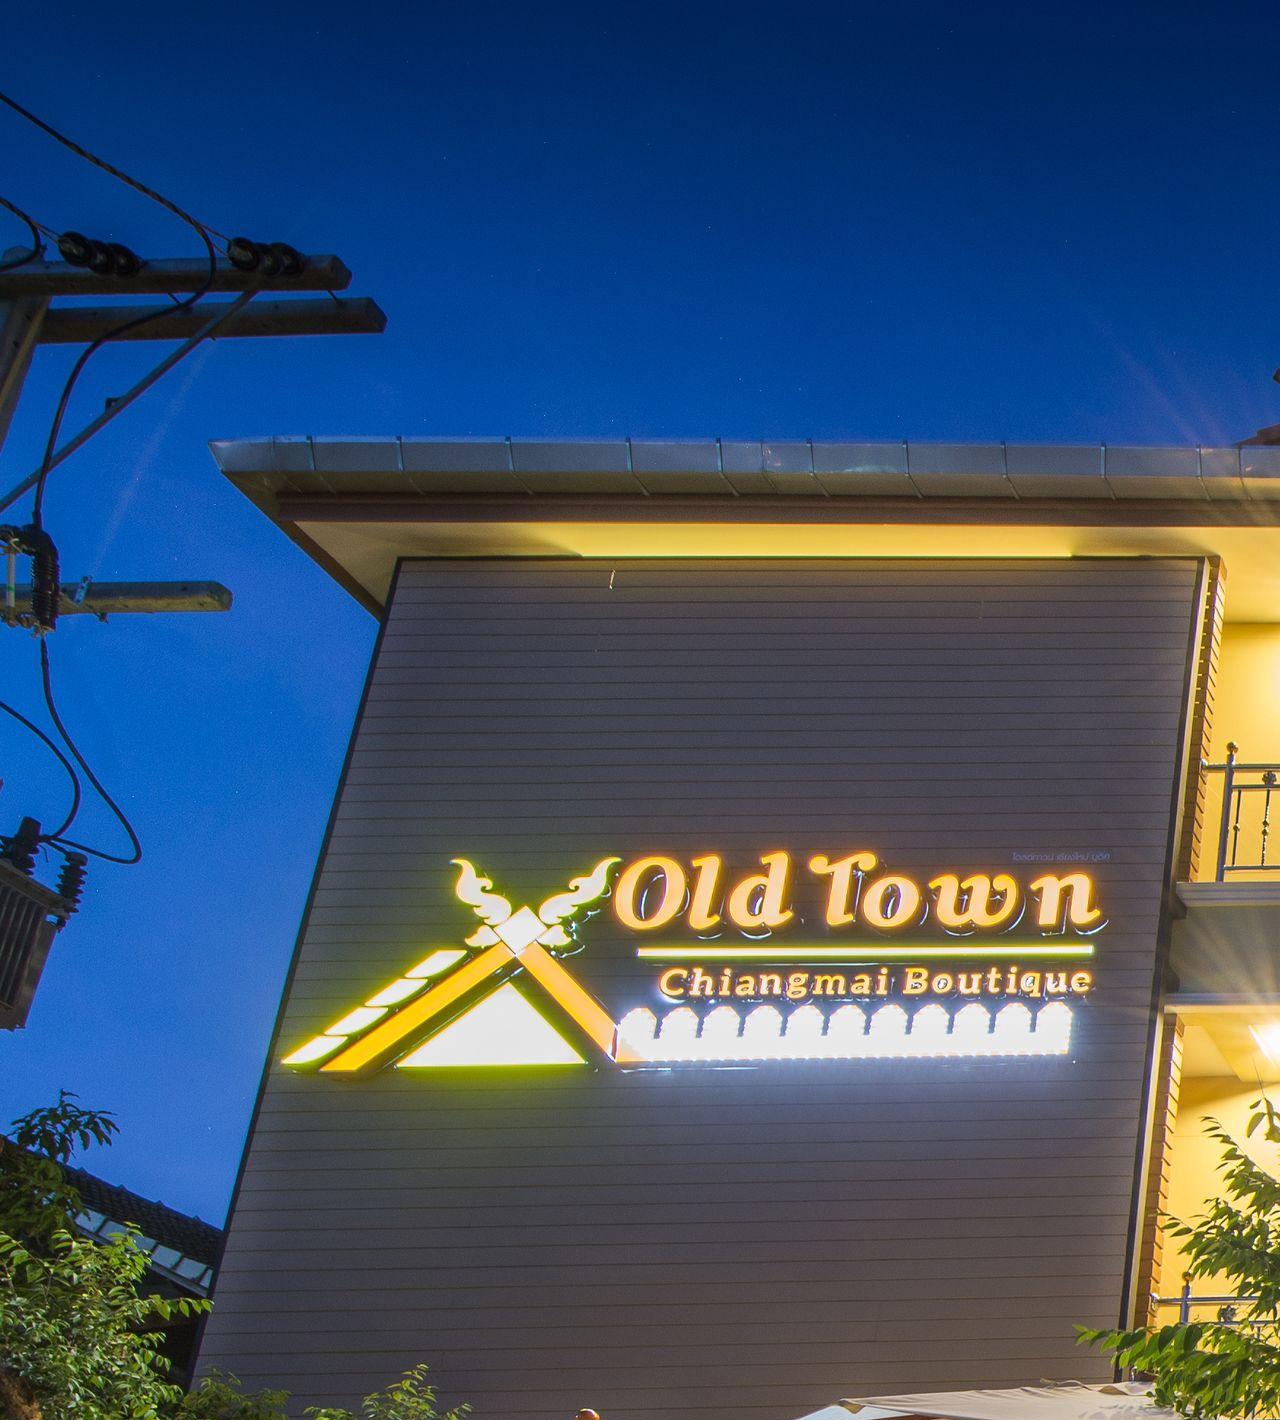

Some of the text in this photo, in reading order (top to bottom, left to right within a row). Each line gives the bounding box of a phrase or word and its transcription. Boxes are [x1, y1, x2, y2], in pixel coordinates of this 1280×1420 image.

[614, 850, 1101, 930] Old Town
[659, 966, 1093, 999] Chiangmai Boutique
